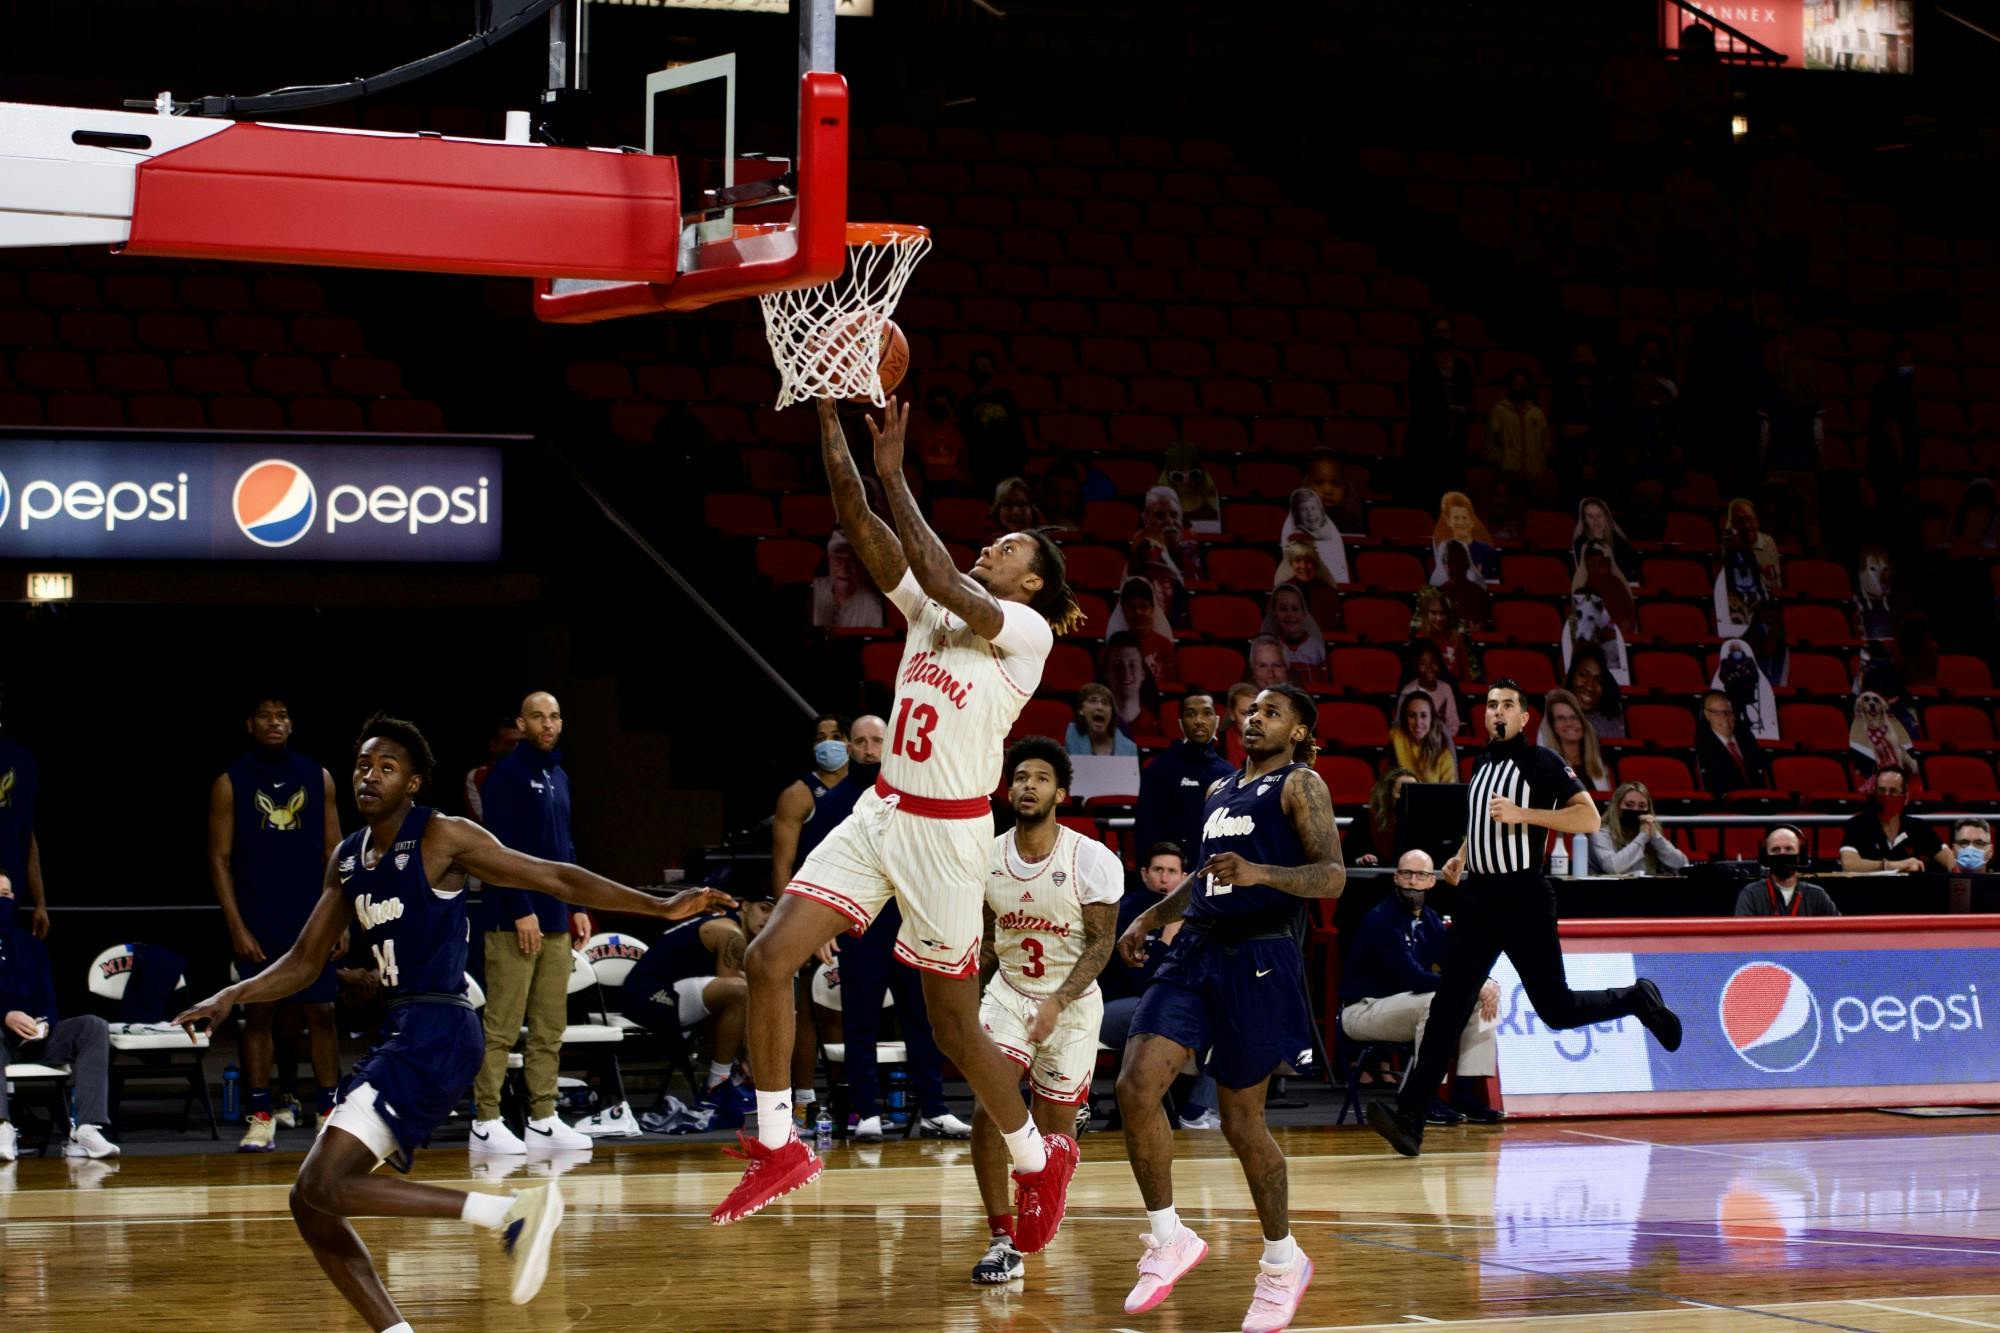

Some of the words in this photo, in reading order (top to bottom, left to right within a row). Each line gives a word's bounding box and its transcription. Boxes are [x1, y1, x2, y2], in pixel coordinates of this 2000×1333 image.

[1705, 5, 1777, 23] ANNEX
[20, 472, 188, 531] pepsi
[326, 476, 489, 534] pepsi
[901, 650, 973, 710] Miami
[892, 697, 939, 763] 13
[371, 939, 399, 987] 14
[1020, 937, 1045, 978] 3
[1832, 984, 1983, 1044] pepsi
